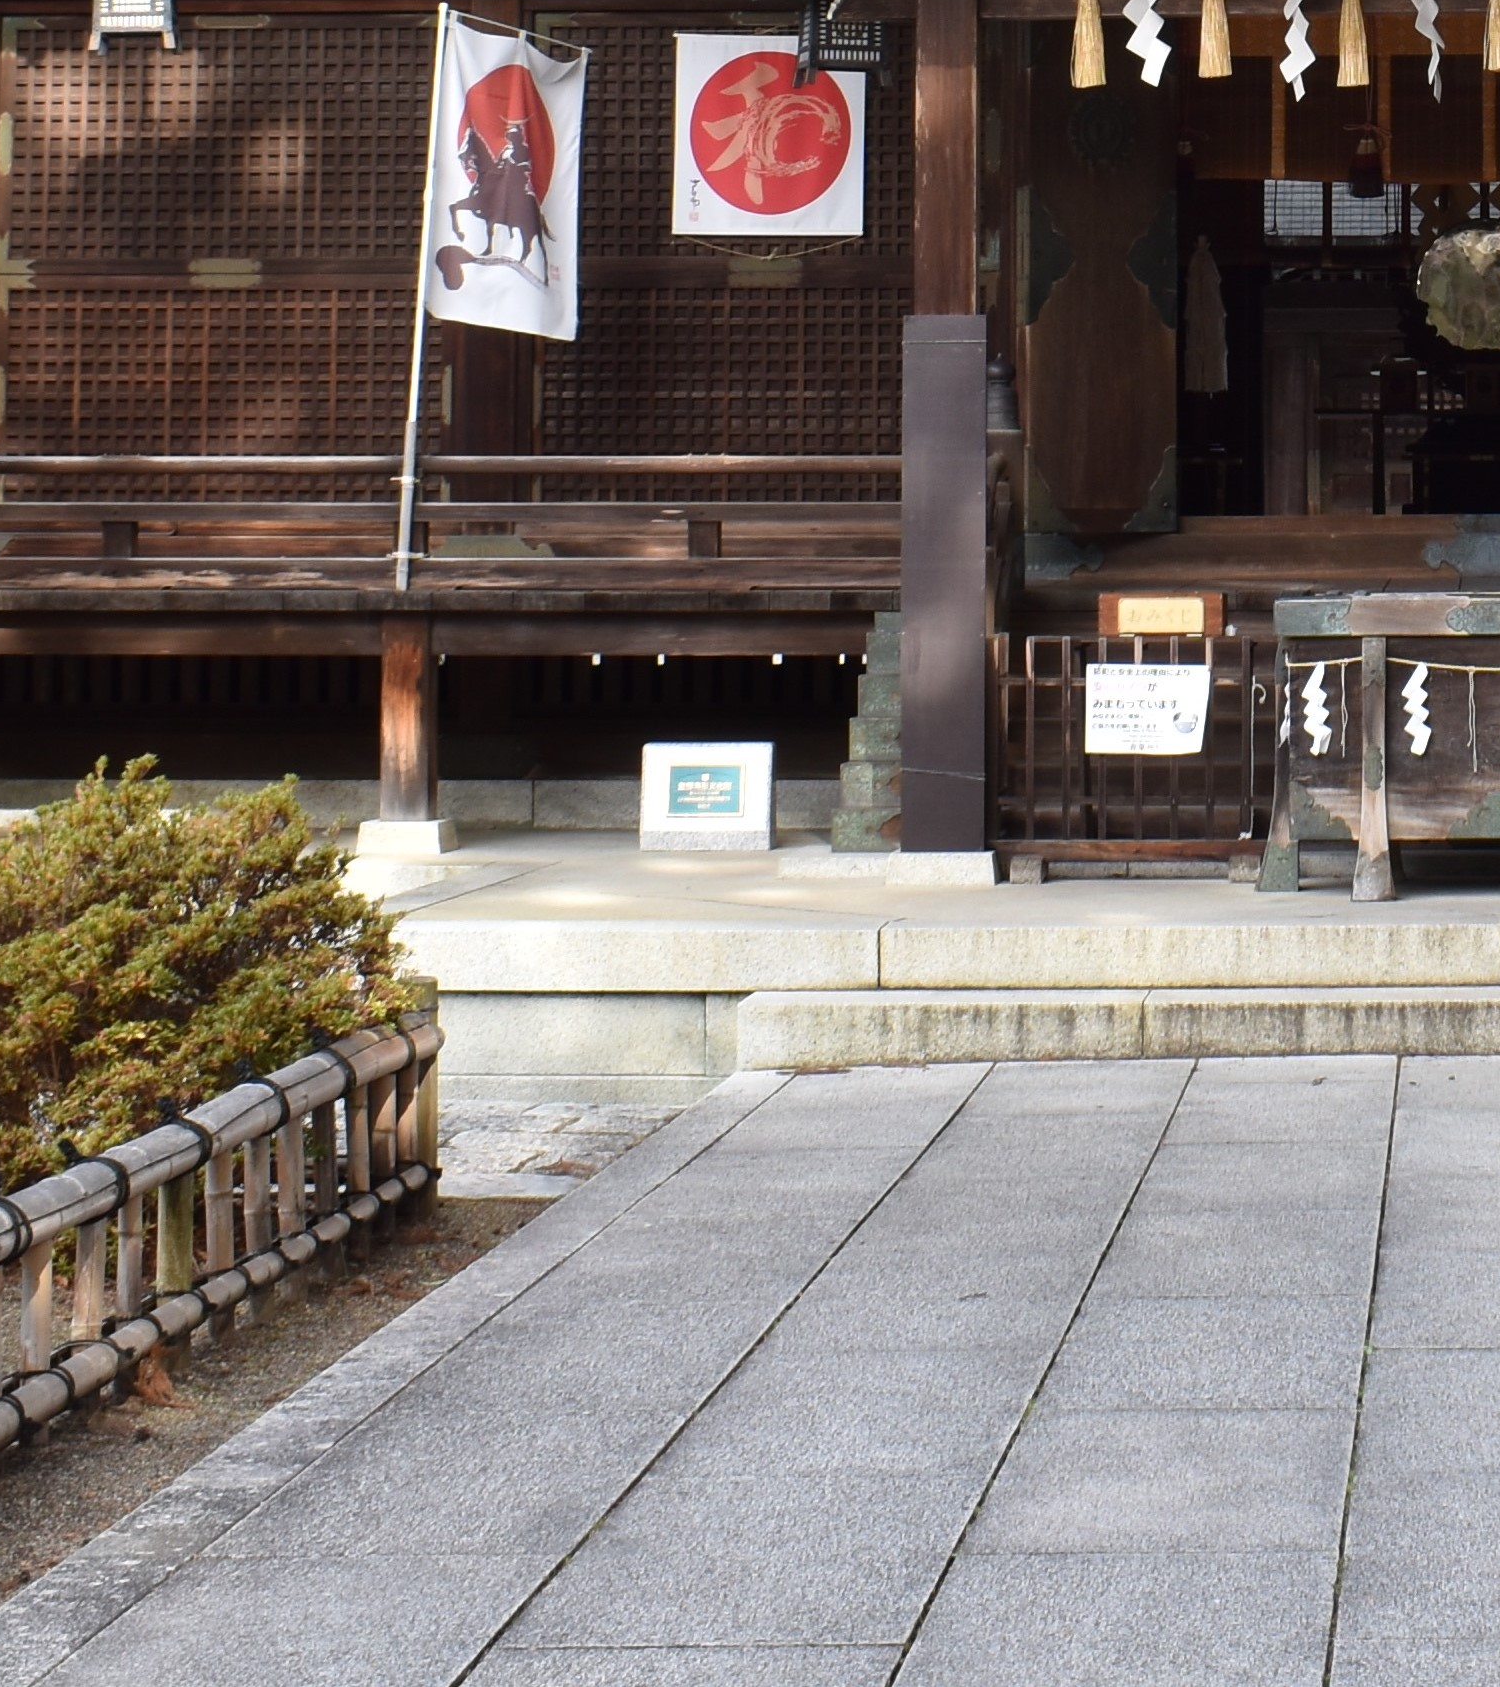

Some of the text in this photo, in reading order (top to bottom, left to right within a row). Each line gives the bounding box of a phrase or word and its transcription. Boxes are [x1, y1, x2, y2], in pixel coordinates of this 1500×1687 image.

[1128, 608, 1193, 624] おみくじ
[1092, 699, 1178, 710] みまもっています
